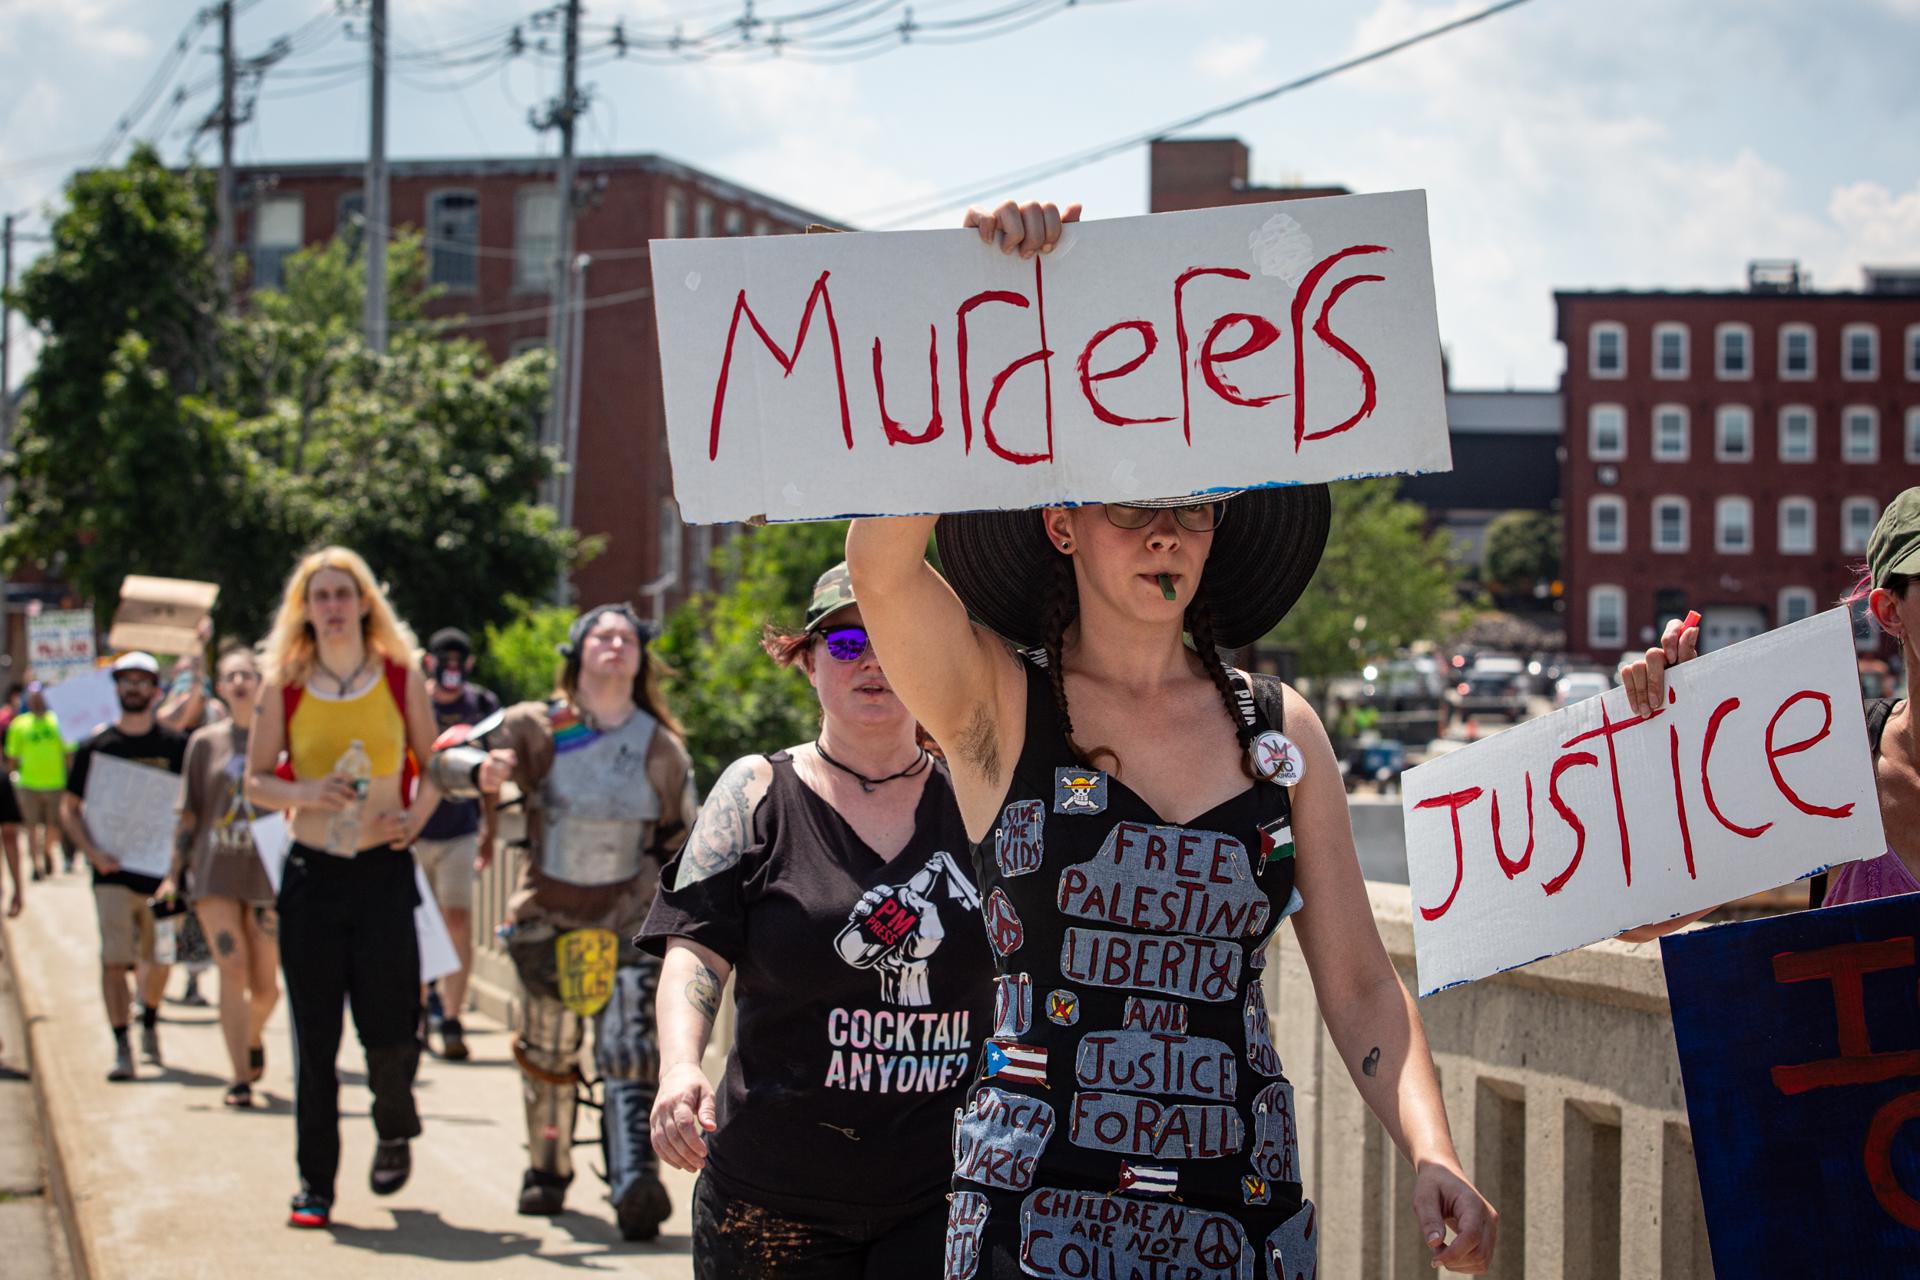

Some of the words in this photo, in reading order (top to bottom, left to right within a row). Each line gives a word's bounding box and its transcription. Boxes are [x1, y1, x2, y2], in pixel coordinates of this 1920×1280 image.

[709, 244, 1393, 464] Murderers
[1273, 761, 1294, 772] NO
[1001, 840, 1041, 872] KIDS
[1114, 821, 1242, 884] FREE
[865, 915, 899, 946] PRESS
[875, 898, 919, 937] PM
[827, 1007, 971, 1052] COCKTAIL
[1123, 999, 1188, 1032] AND
[824, 1050, 969, 1094] ANYONE?
[1154, 1107, 1238, 1160] ALL
[1033, 1191, 1184, 1235] CHILDREN
[1071, 1220, 1116, 1247] ARE
[1125, 1232, 1189, 1258] NOT
